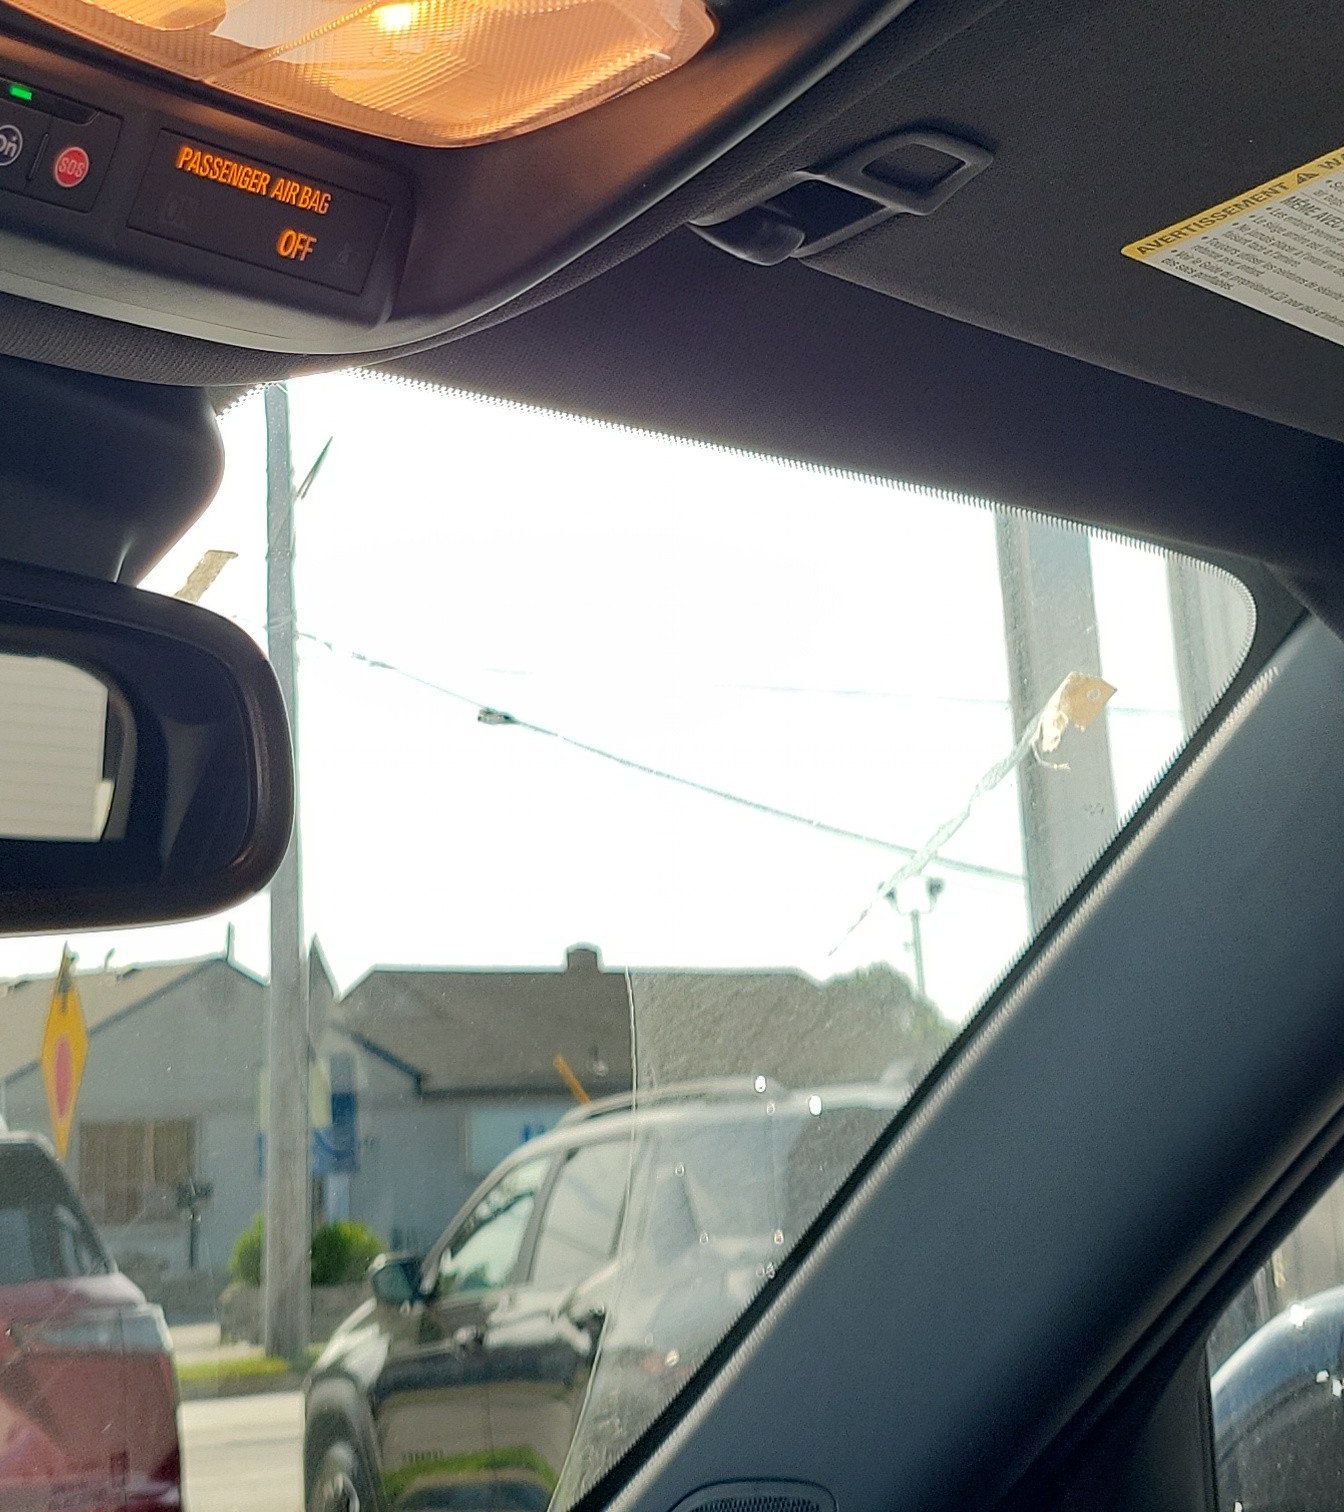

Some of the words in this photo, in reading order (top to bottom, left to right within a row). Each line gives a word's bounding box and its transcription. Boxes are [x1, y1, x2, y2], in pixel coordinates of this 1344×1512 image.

[58, 156, 86, 178] SOS
[176, 146, 271, 196] PASSENGER
[271, 180, 299, 205] AIR
[297, 187, 332, 216] BAG
[1137, 182, 1290, 254] AVERTISSEMENT
[1277, 193, 1326, 216] MÊME
[277, 228, 318, 262] OFF
